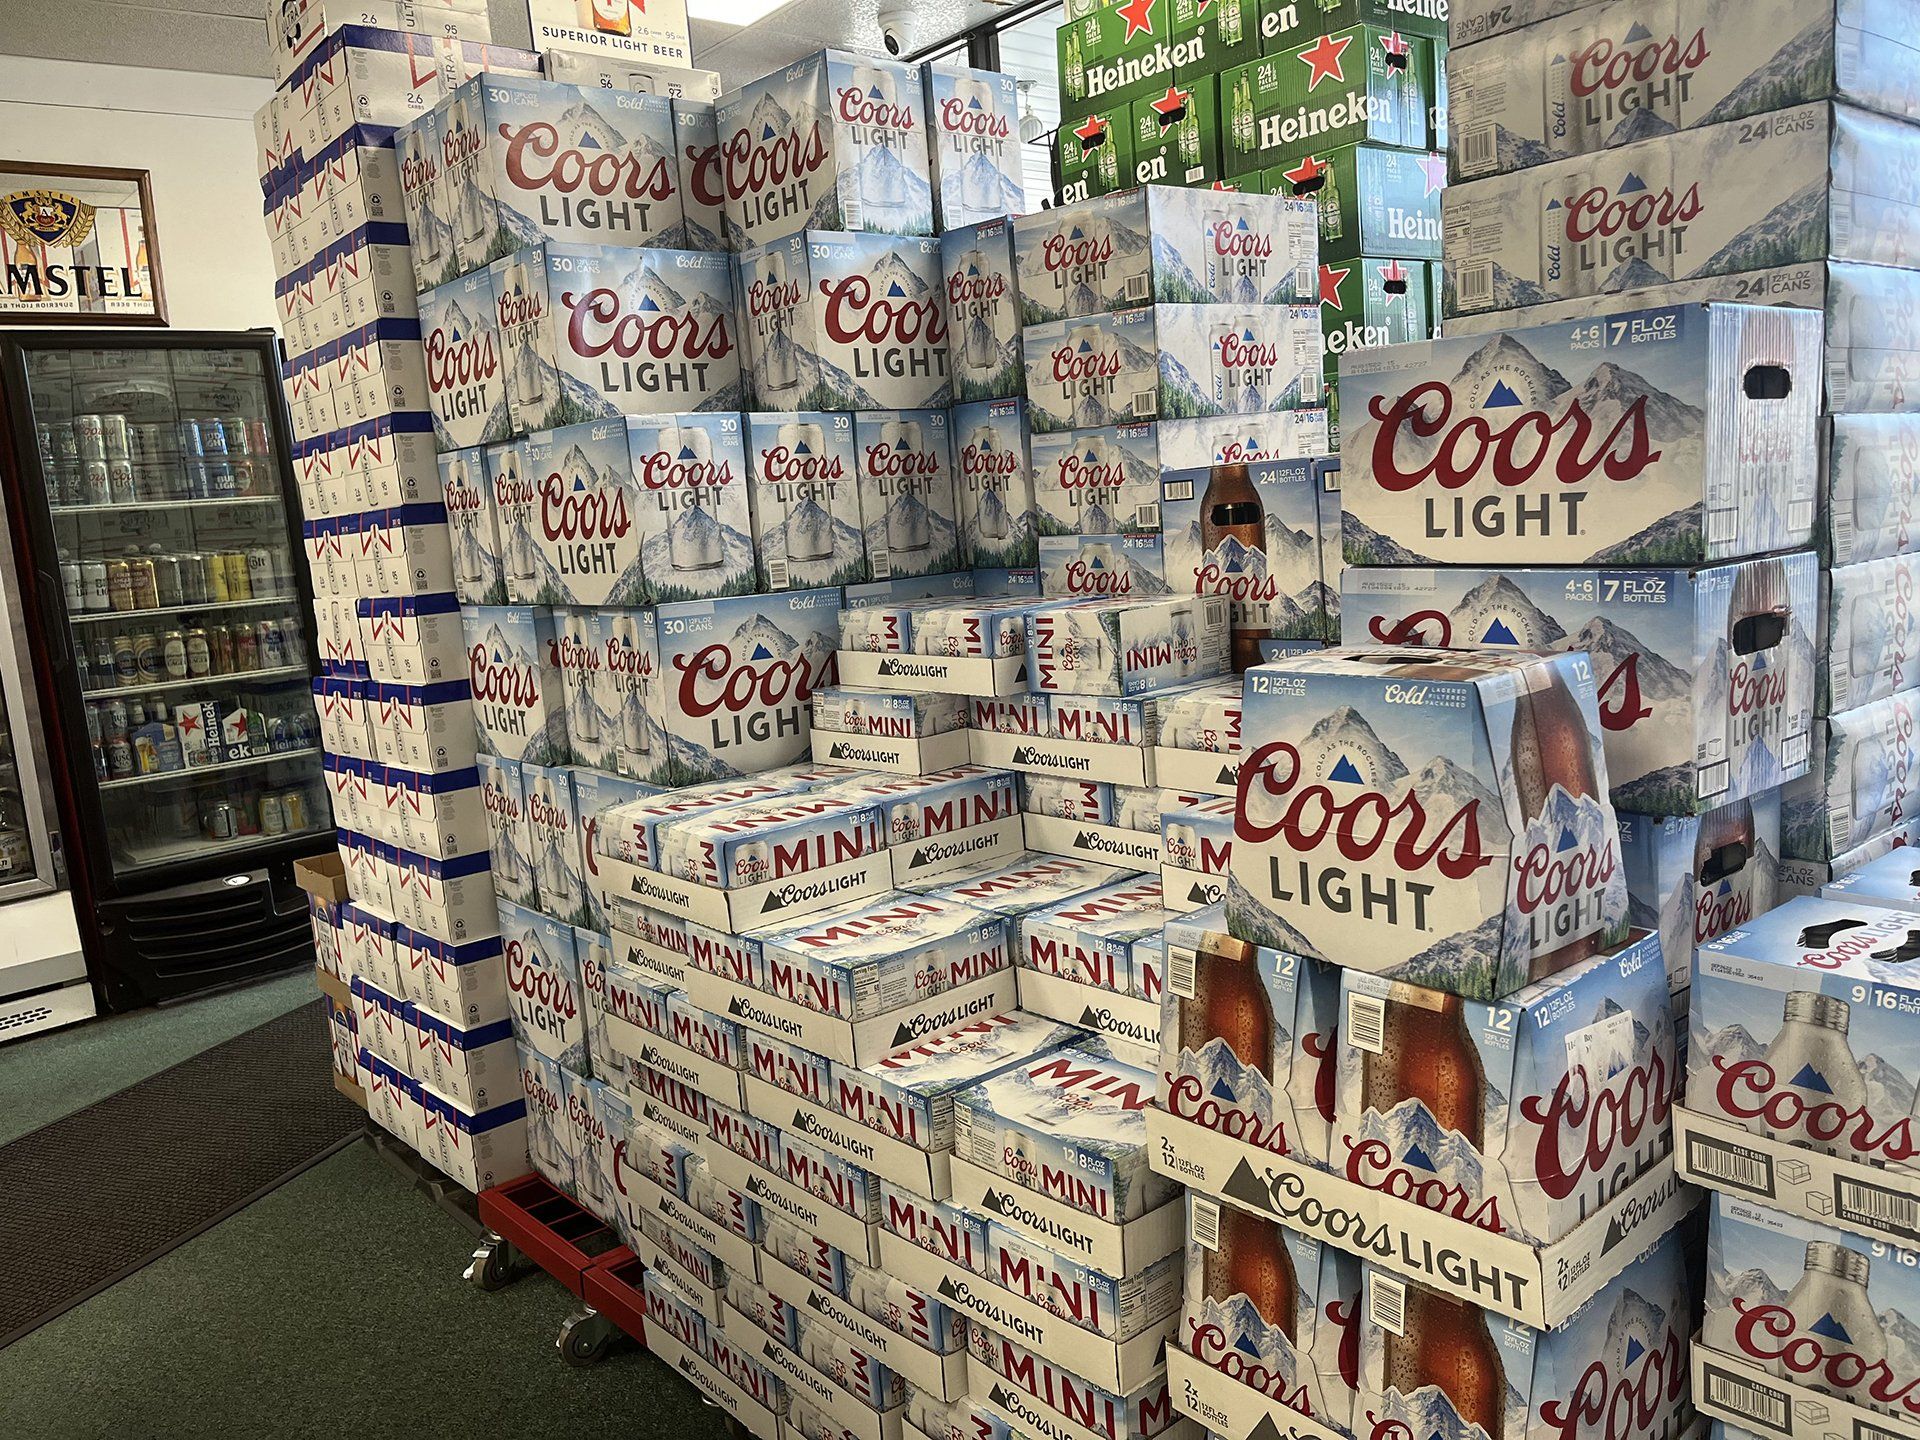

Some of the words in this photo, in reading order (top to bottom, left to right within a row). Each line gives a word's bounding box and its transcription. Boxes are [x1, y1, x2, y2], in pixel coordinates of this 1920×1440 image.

[361, 13, 377, 25] 2.6
[445, 23, 457, 35] 95
[1456, 13, 1485, 31] CANS
[1488, 4, 1512, 29] 24
[541, 26, 607, 46] SUPERIOR
[612, 37, 648, 53] LIGHT
[653, 46, 683, 59] BEER
[637, 26, 649, 36] 2.6
[665, 31, 676, 40] 95
[905, 69, 919, 80] 30
[1087, 40, 1205, 98] Heineken
[1257, 63, 1271, 78] 24
[1570, 27, 1713, 98] Coors
[407, 93, 423, 104] 2.6
[488, 89, 509, 103] 30
[1000, 80, 1014, 92] 30
[616, 95, 643, 110] Cold
[837, 87, 914, 129] Coors
[1585, 72, 1695, 128] LIGHT
[941, 98, 1010, 138] Coors
[1259, 92, 1392, 150] Heineken
[1552, 100, 1565, 140] Cold
[1774, 119, 1815, 137] CANS
[1738, 123, 1768, 145] 24
[499, 122, 676, 201] Coors
[722, 120, 829, 201] Coors
[1564, 181, 1704, 243] Coors
[1213, 220, 1273, 258] Coors
[1580, 224, 1688, 272] LIGHT
[676, 254, 702, 269] Cold
[811, 245, 831, 259] 30
[1043, 234, 1114, 272] Coors
[1548, 243, 1562, 283] Cold
[552, 258, 572, 273] 30
[1054, 260, 1109, 290] LIGHT
[1221, 257, 1267, 278] LIGHT
[748, 278, 801, 317] Coors
[948, 272, 1006, 305] Coors
[1735, 277, 1765, 299] 24
[1771, 278, 1812, 295] CANS
[820, 275, 949, 345] Coor
[561, 288, 734, 359] Coors
[1570, 325, 1600, 342] 4-6
[1611, 321, 1628, 346] 7
[1631, 329, 1677, 343] BOTTLES
[1219, 332, 1278, 368] Coors
[1570, 339, 1600, 351] PACKS
[1051, 345, 1121, 382] Coors
[600, 362, 710, 393] LIGHT
[1062, 376, 1117, 401] LIGHT
[1228, 367, 1274, 388] LIGHT
[720, 420, 737, 432] 30
[833, 417, 849, 429] 30
[930, 415, 944, 426] 30
[1128, 426, 1138, 438] 16
[1368, 381, 1661, 491] Coors
[640, 451, 734, 490] Coors
[761, 446, 845, 482] Coors
[865, 443, 940, 477] Coors
[1058, 454, 1125, 490] Coors
[879, 476, 935, 497] LIGHT
[1259, 471, 1276, 485] 24
[659, 486, 724, 511] LIGHT
[776, 482, 838, 502] LIGHT
[1069, 486, 1121, 507] LIGHT
[538, 473, 631, 542] Coors
[1425, 491, 1589, 538] LIGHT
[557, 542, 618, 575] LIGHT
[1565, 580, 1593, 593] 4-6
[1604, 582, 1620, 603] 7
[1623, 592, 1667, 604] BOTTLES
[789, 596, 816, 611] Cold
[664, 620, 684, 635] 30
[1036, 618, 1058, 690] MINI
[1126, 642, 1173, 673] MINI
[467, 644, 539, 708] Coors
[1573, 661, 1590, 680] 12
[1251, 675, 1268, 693] 12
[1272, 686, 1306, 697] BOTTLES
[1384, 683, 1428, 705] Cold
[1728, 661, 1787, 717] Coors
[484, 704, 528, 737] LIGHT
[868, 714, 911, 738] MINI
[924, 787, 1013, 828] MINI
[1233, 742, 1494, 879] Coors
[774, 822, 878, 878] MINI
[954, 859, 1084, 899] MINI
[1514, 838, 1616, 914] Coors
[1269, 855, 1436, 932] LIGHT
[795, 902, 944, 948] MINI
[1528, 887, 1607, 949] LIGHT
[967, 932, 979, 944] 12
[981, 928, 989, 941] 8
[950, 944, 1002, 985] MINI
[1275, 955, 1294, 977] 12
[1619, 949, 1643, 979] Cold
[503, 937, 576, 1019] Coors
[1851, 985, 1864, 1003] 9
[1875, 989, 1897, 1010] 16
[518, 997, 567, 1044] LIGHT
[1486, 1007, 1512, 1031] 12
[1534, 1007, 1551, 1029] 12
[1164, 1071, 1292, 1157] Coors
[1712, 1054, 1920, 1161] Coors
[1520, 1046, 1677, 1200] Coor
[1063, 1146, 1075, 1164] 12
[1079, 1153, 1088, 1168] 8
[1161, 1136, 1175, 1153] 2x
[1733, 1146, 1749, 1156] CASE
[1750, 1151, 1768, 1162] CODE
[1162, 1152, 1175, 1168] 12
[1042, 1169, 1108, 1217] MINI
[1343, 1135, 1506, 1234] Coors
[1872, 1219, 1891, 1232] CODE
[1556, 1256, 1570, 1276] 2x
[1871, 1242, 1886, 1258] 9
[1895, 1248, 1918, 1267] 16
[1088, 1274, 1096, 1289] 8
[1003, 1341, 1115, 1438] MINI
[1184, 1379, 1199, 1397] 2x
[1751, 1382, 1767, 1393] CASE
[1768, 1388, 1785, 1400] CODE
[1185, 1394, 1199, 1411] 12
